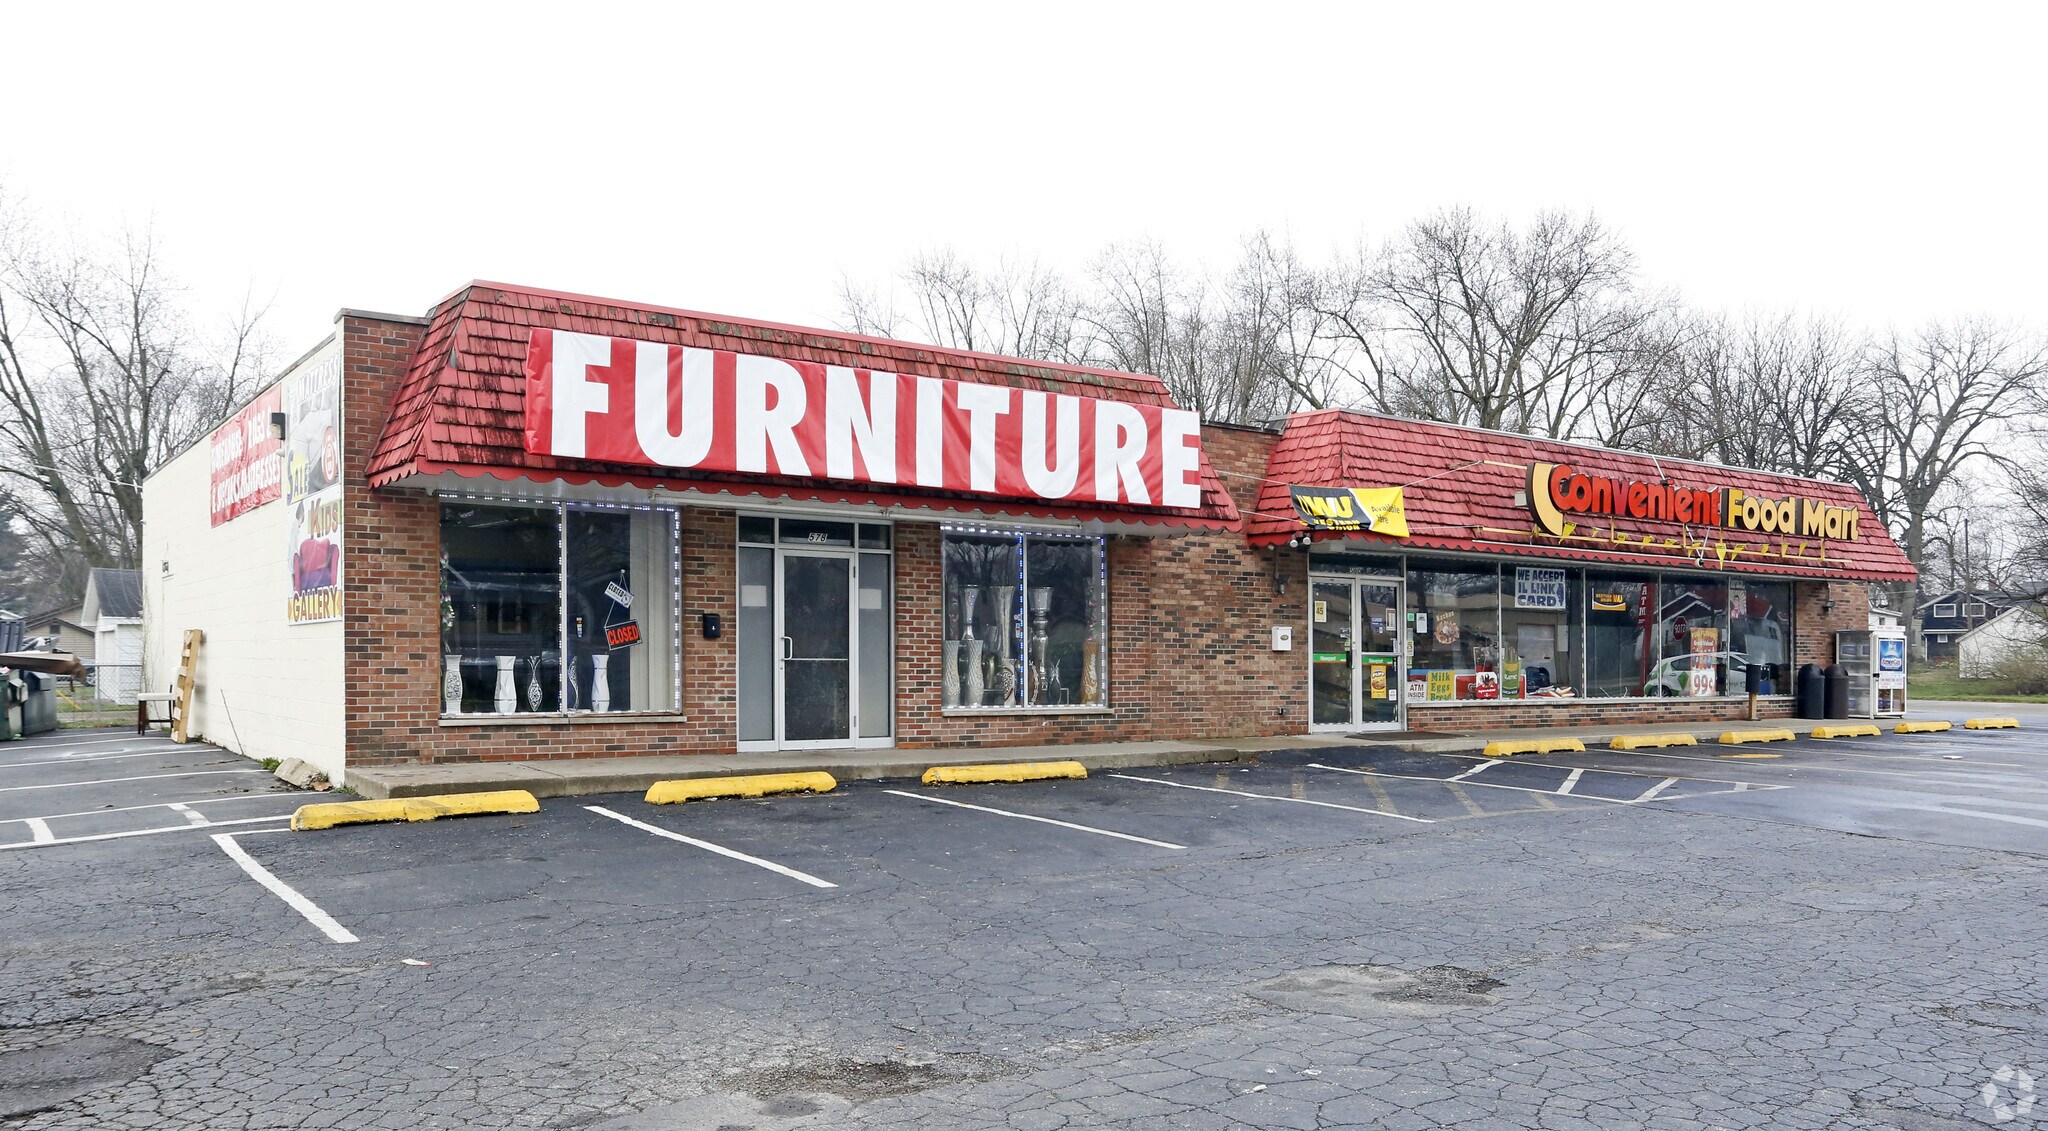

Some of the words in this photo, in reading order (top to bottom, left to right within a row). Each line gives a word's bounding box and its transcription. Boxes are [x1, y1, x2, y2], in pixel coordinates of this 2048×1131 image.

[551, 329, 1201, 509] FURNITURE
[1549, 463, 1721, 526] Convenient
[1728, 488, 1796, 533] Food
[1802, 498, 1859, 541] Mart
[1371, 504, 1400, 514] Available
[808, 533, 827, 542] 578
[1517, 569, 1530, 581] WE
[1532, 570, 1564, 581] ACCEPT
[608, 583, 624, 598] CLOSED
[1518, 582, 1527, 593] IL
[1531, 582, 1555, 595] LINK
[293, 584, 338, 622] GALLERY
[1517, 595, 1557, 607] CARD
[1638, 586, 1648, 616] ATM
[1316, 607, 1324, 615] 45
[607, 625, 639, 646] CLOSED
[1431, 672, 1450, 681] Milk
[1430, 682, 1450, 692] Eggs
[1431, 692, 1452, 701] Bread
